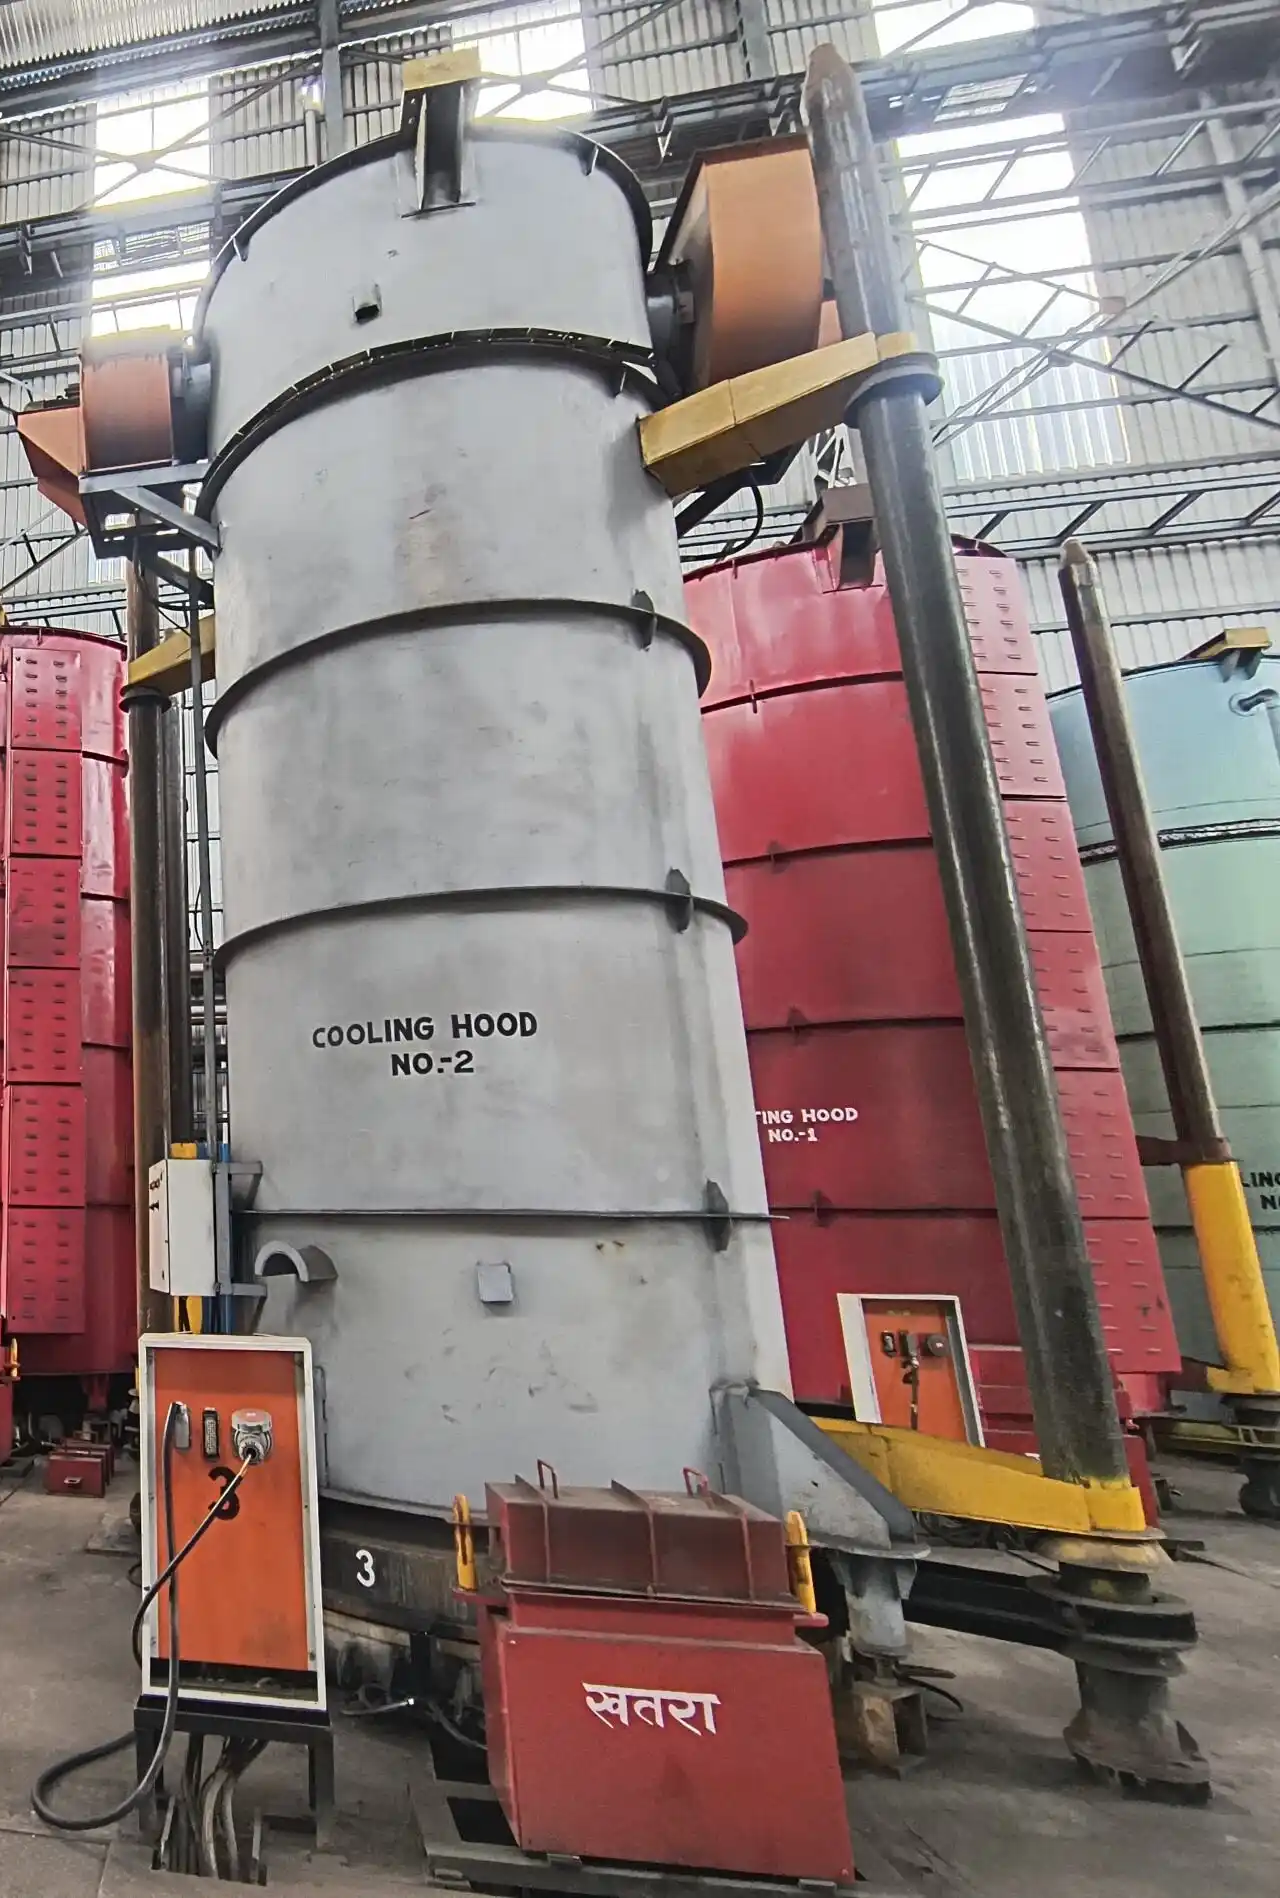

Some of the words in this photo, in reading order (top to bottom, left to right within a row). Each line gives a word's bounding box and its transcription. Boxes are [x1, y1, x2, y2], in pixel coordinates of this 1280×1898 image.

[312, 1016, 435, 1049] COOLING
[450, 1011, 538, 1040] HOOD
[391, 1050, 475, 1077] NO.-2
[800, 1107, 859, 1122] HOOD
[767, 1127, 818, 1142] NO.-1
[207, 1466, 241, 1521] 3
[355, 1549, 376, 1588] 3
[582, 1682, 722, 1737] खतरा
